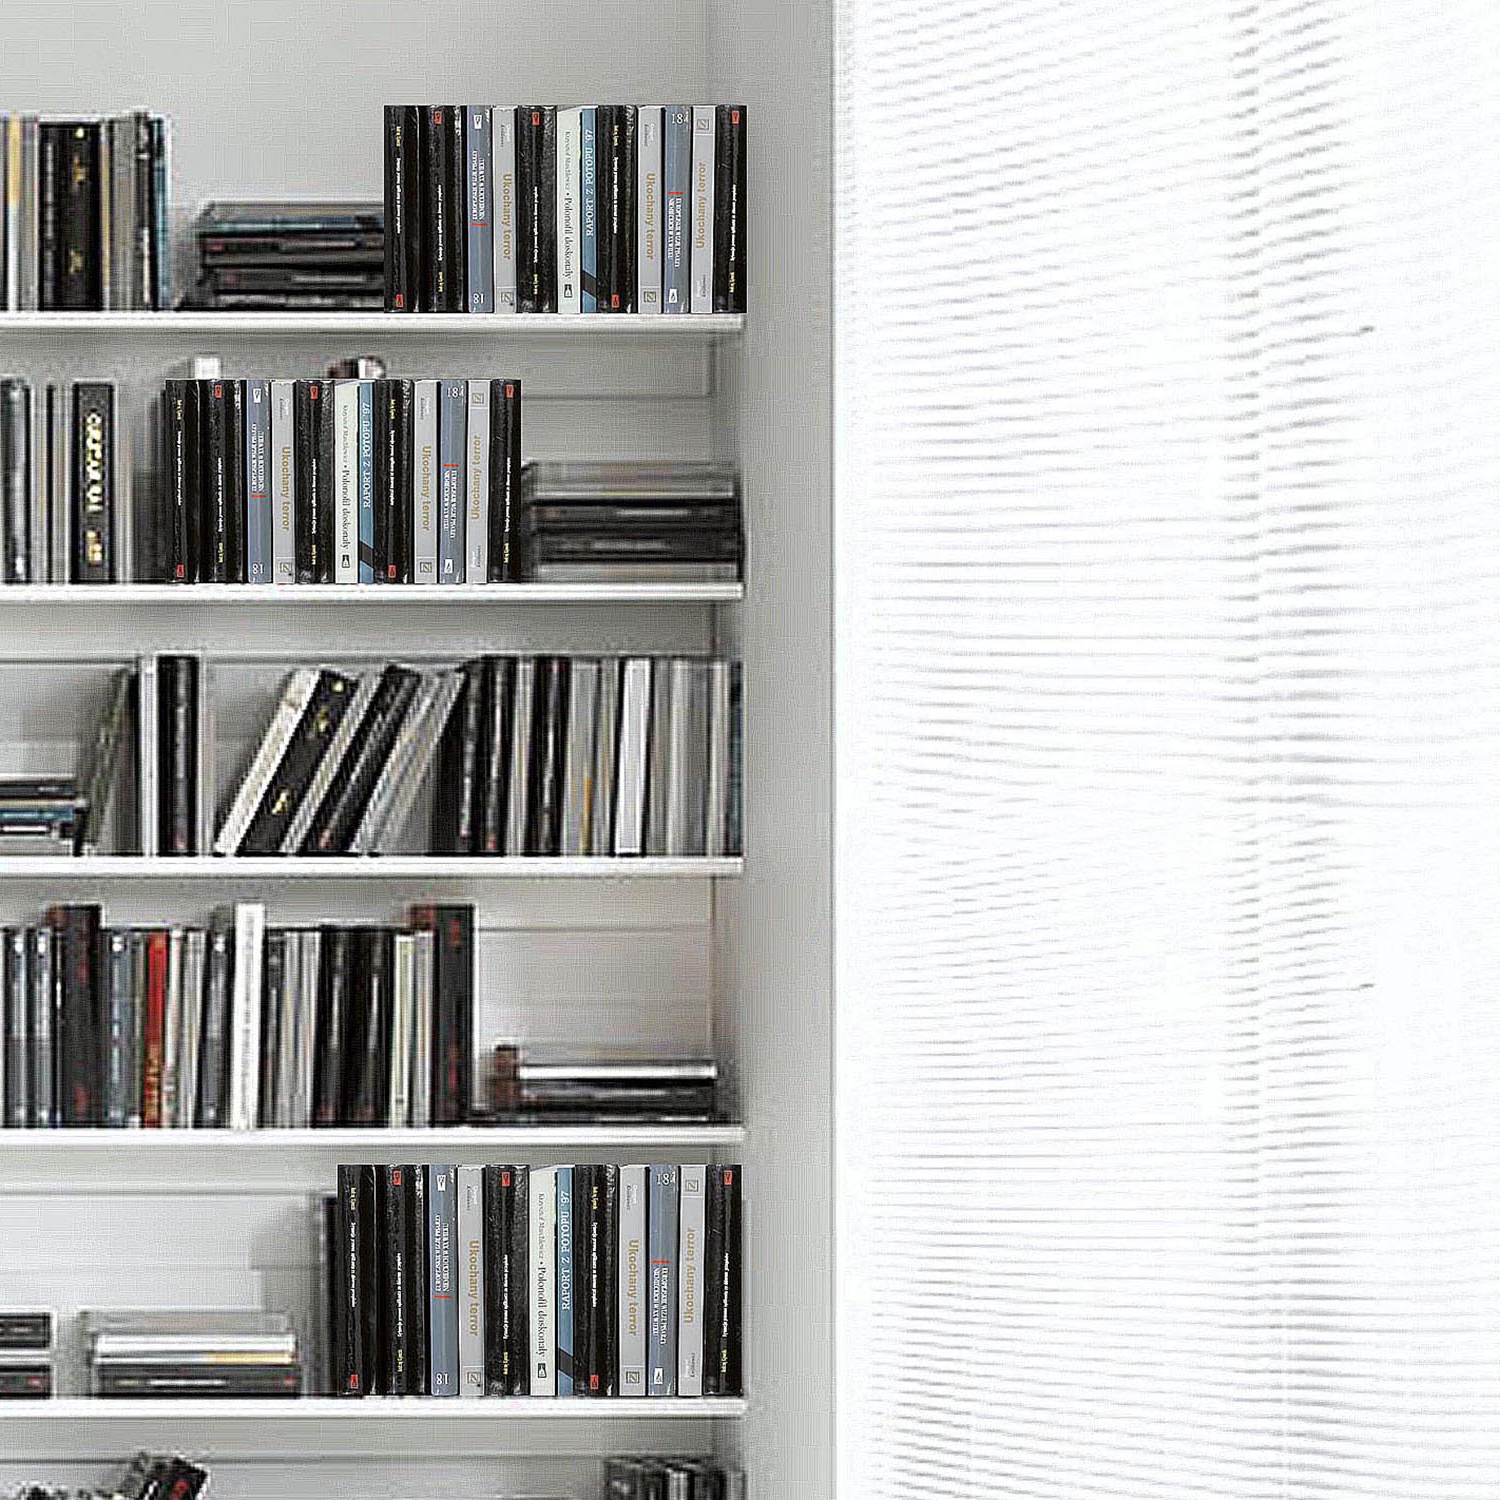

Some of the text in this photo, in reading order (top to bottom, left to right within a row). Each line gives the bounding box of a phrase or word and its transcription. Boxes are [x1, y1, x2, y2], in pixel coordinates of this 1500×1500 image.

[672, 113, 684, 124] 18
[586, 148, 594, 185] POTOPU
[501, 173, 512, 260] Ukochany terror
[564, 197, 573, 235] Polonofil
[586, 198, 594, 236] RAPORT
[645, 173, 656, 260] Ukochany terror
[696, 162, 707, 249] Ukochany terror
[473, 292, 484, 305] 18
[447, 387, 459, 398] 18
[363, 420, 371, 457] POTOPU
[280, 446, 291, 531] Ukochany terror
[341, 469, 350, 506] Polonofil
[363, 471, 371, 507] RAPORT
[421, 445, 432, 531] Ukochany terror
[471, 435, 481, 520] Ukochany terror
[252, 563, 264, 575] 18
[657, 1173, 670, 1185] 18
[561, 1212, 570, 1253] POTOPU
[468, 1240, 479, 1336] Ukochany terror
[538, 1267, 547, 1308] Polonofil
[561, 1269, 570, 1310] RAPORT
[627, 1239, 639, 1336] Ukochany terror
[684, 1228, 696, 1324] Ukochany terror
[536, 1310, 547, 1357] doskonały
[435, 1373, 448, 1386] 18
